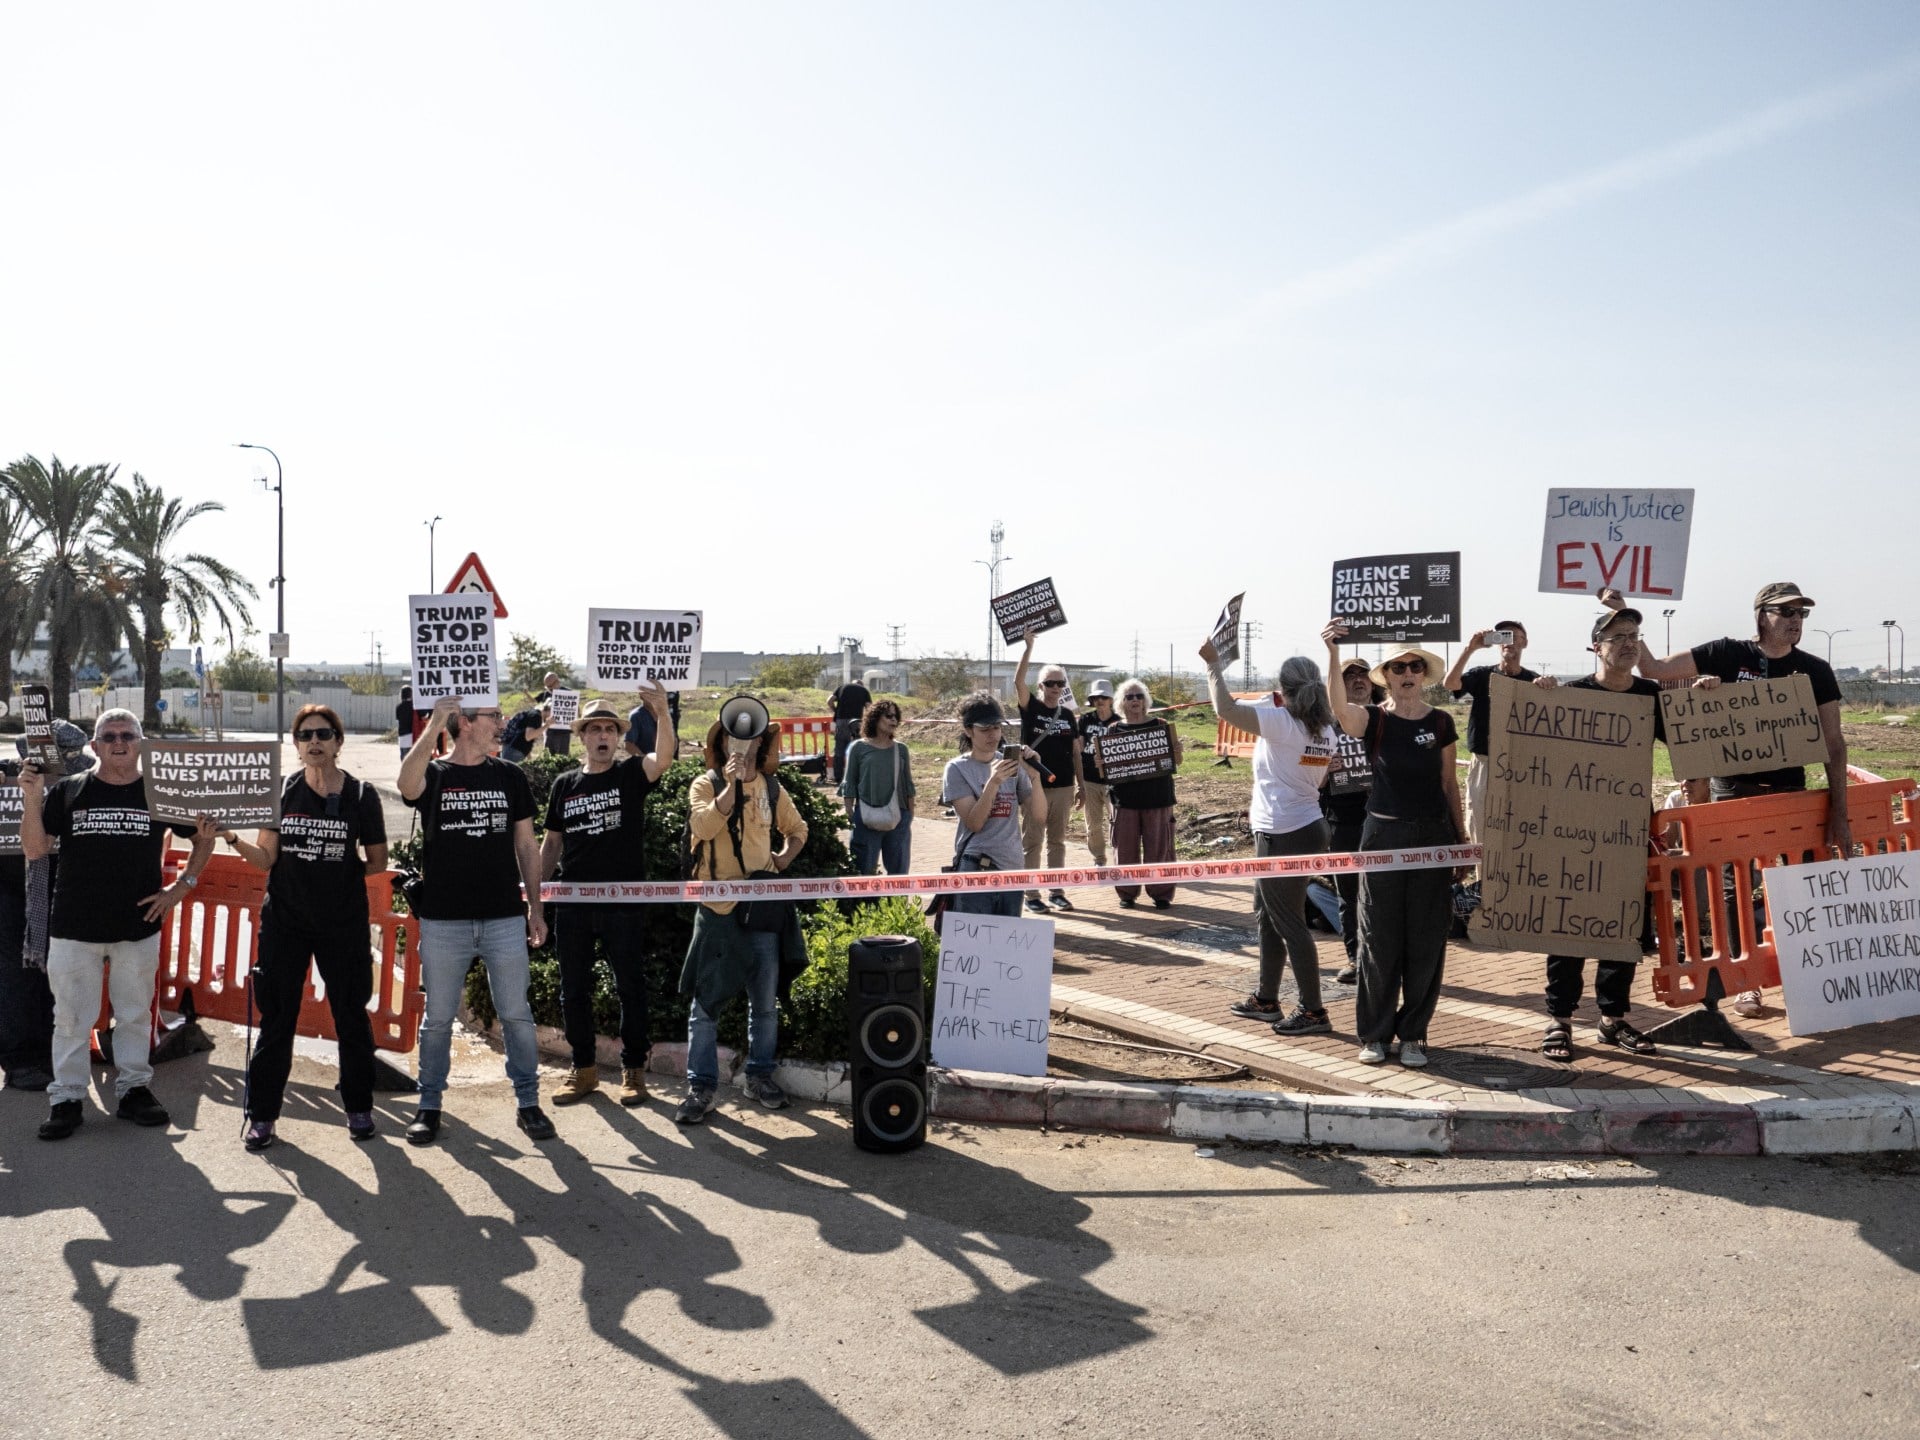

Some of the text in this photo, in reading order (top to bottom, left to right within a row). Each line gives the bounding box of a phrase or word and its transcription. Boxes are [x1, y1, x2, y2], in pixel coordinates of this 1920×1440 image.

[1552, 493, 1685, 522] Jewish Justice
[1608, 521, 1623, 542] is
[1336, 565, 1411, 584] SILENCE
[1556, 541, 1673, 596] EVIL
[994, 582, 1050, 609] DEMOCRACY AND
[1336, 581, 1400, 599] MEANS
[996, 589, 1054, 618] OCCUPATION
[1334, 596, 1423, 614] CONSENT
[415, 606, 487, 622] TRUMP
[1000, 610, 1027, 625] CANNOT
[1027, 598, 1056, 615] COEXIST
[1387, 615, 1410, 627] ليس
[1412, 613, 1450, 627] السكوت
[417, 622, 488, 643] STOP
[598, 620, 693, 643] TRUMP
[417, 643, 489, 654] THE ISRAELI
[598, 643, 692, 654] STOP THE ISRAELI
[417, 654, 489, 669] TERROR
[597, 654, 691, 665] TERROR IN THE
[418, 669, 490, 686] IN THE
[597, 667, 689, 680] WEST BANK
[419, 685, 490, 696] WEST BANK
[29, 694, 45, 705] AND
[1662, 683, 1787, 719] Put an end to
[26, 724, 51, 735] OEXIST
[1671, 707, 1820, 748] Israel's impunity
[1101, 730, 1166, 747] DEMOCRACY AND
[1102, 737, 1168, 756] OCCUPATION
[151, 752, 271, 766] PALESTINIAN
[1104, 746, 1170, 764] CANNOT COEXIST
[152, 767, 271, 782] LIVES MATTER
[1495, 752, 1646, 798] South Africa
[441, 791, 506, 801] PALESTINIAN
[564, 788, 620, 810] PALESTINIAN
[441, 800, 509, 811] LIVES MATTER
[564, 797, 621, 819] LIVES MATTER
[88, 811, 124, 821] להאבק
[126, 812, 150, 822] חובה
[72, 821, 120, 831] המתנחלים
[281, 817, 348, 830] PALESTINIAN
[1512, 804, 1548, 850] get
[1554, 826, 1597, 854] away
[1603, 819, 1633, 846] with
[280, 826, 347, 839] LIVES MATTER
[1366, 854, 1394, 865] משטרת
[1401, 853, 1421, 863] מעבר
[1422, 851, 1432, 864] אין
[1205, 864, 1229, 875] ישראל
[1279, 861, 1299, 871] מעבר
[1300, 859, 1311, 871] אין
[1158, 868, 1178, 877] מעבר
[1178, 867, 1189, 878] אין
[1486, 851, 1602, 903] Why the hell
[767, 883, 793, 894] משטרת
[799, 883, 819, 893] מעבר
[820, 882, 830, 894] אין
[846, 880, 869, 892] ישראל
[965, 876, 988, 887] ישראל
[1803, 865, 1908, 898] THEY TOOK
[578, 887, 596, 897] מעבר
[621, 885, 642, 897] ישראל
[655, 886, 680, 896] משטרת
[686, 886, 704, 896] מעבר
[705, 886, 715, 897] אין
[730, 883, 752, 895] ישראל
[1482, 892, 1641, 939] should Israel?
[1783, 906, 1816, 936] SDE
[1822, 901, 1877, 929] TEIMAN
[954, 919, 1038, 950] PUT AN
[1802, 933, 1920, 969] AS THEY ALREAD
[941, 950, 1023, 981] END TO
[1823, 967, 1920, 1004] OWN HAKIRY
[942, 981, 992, 1014] THE
